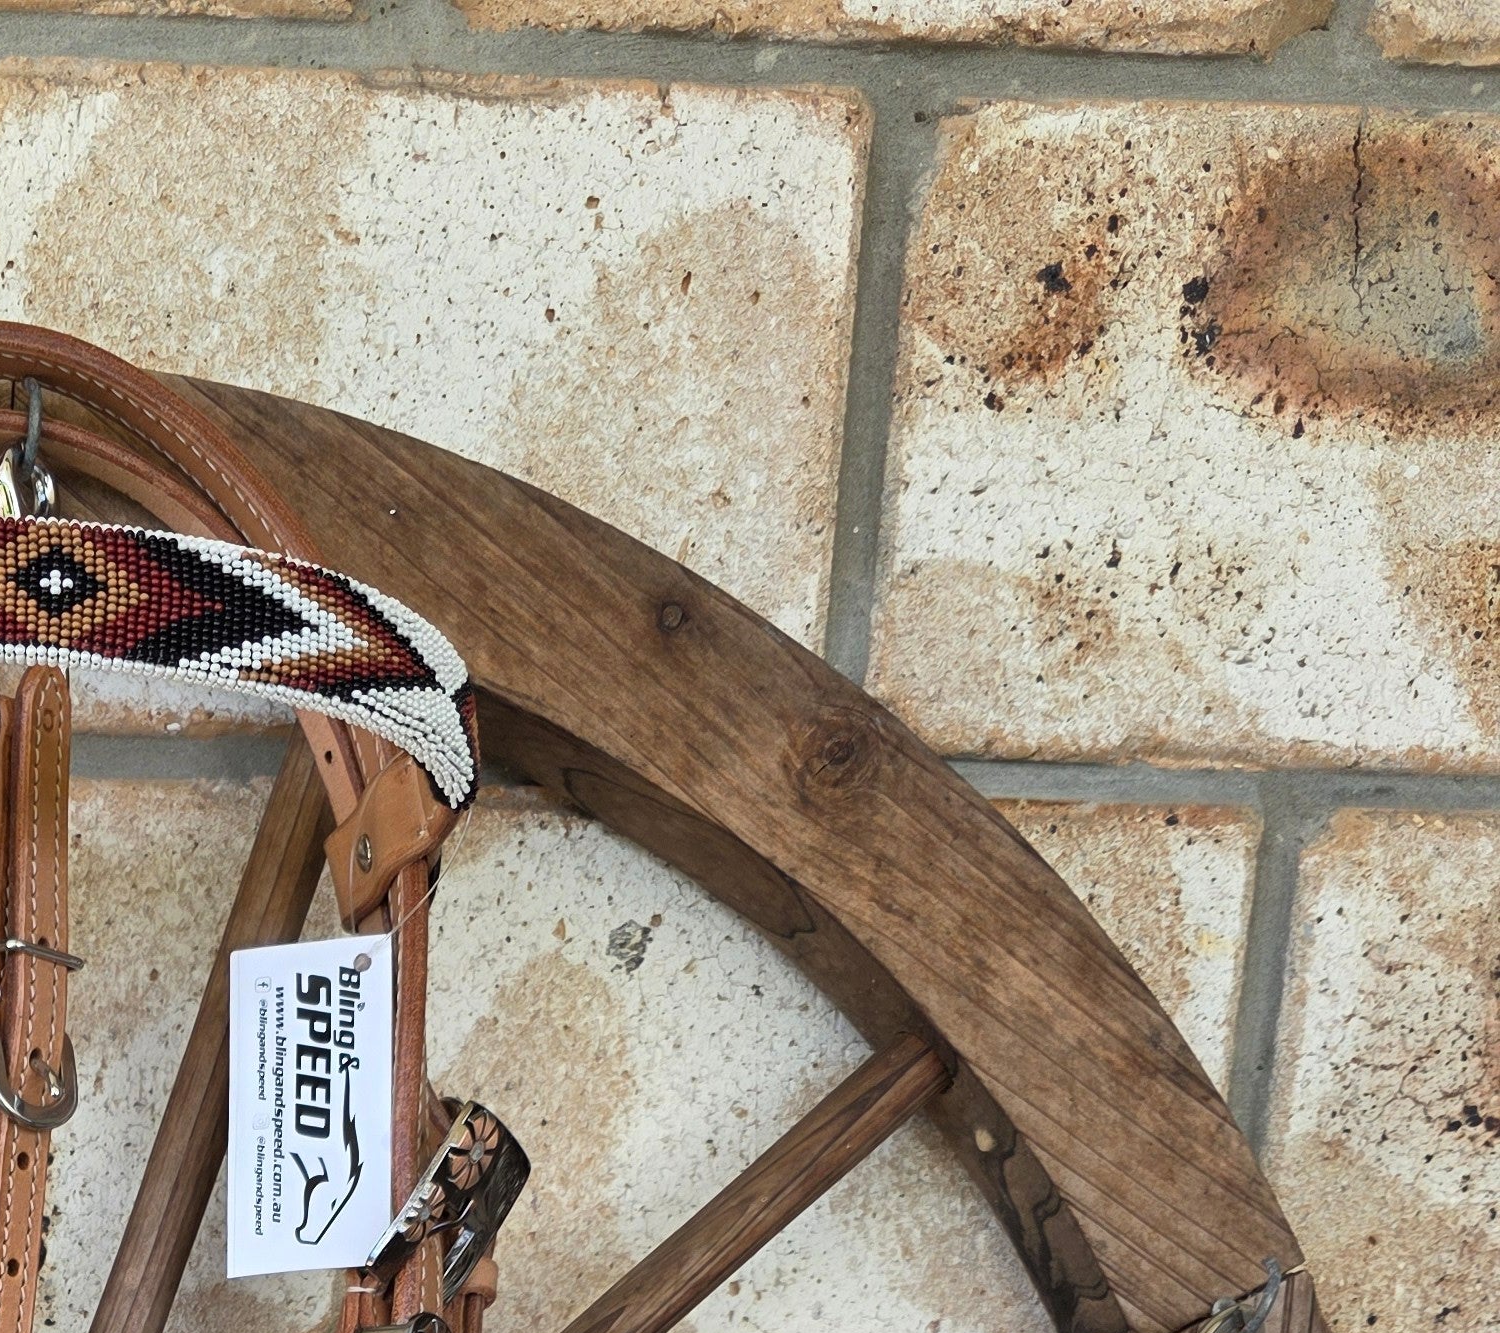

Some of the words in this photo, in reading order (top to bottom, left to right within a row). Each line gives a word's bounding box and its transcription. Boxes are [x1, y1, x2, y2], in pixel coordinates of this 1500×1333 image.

[257, 998, 269, 1101] @blingandspeed
[295, 972, 332, 1139] SPEED
[333, 966, 362, 1049] Bling
[272, 986, 287, 1223] www.blingandspeed.com.au
[254, 1136, 266, 1236] @blingandspeed
